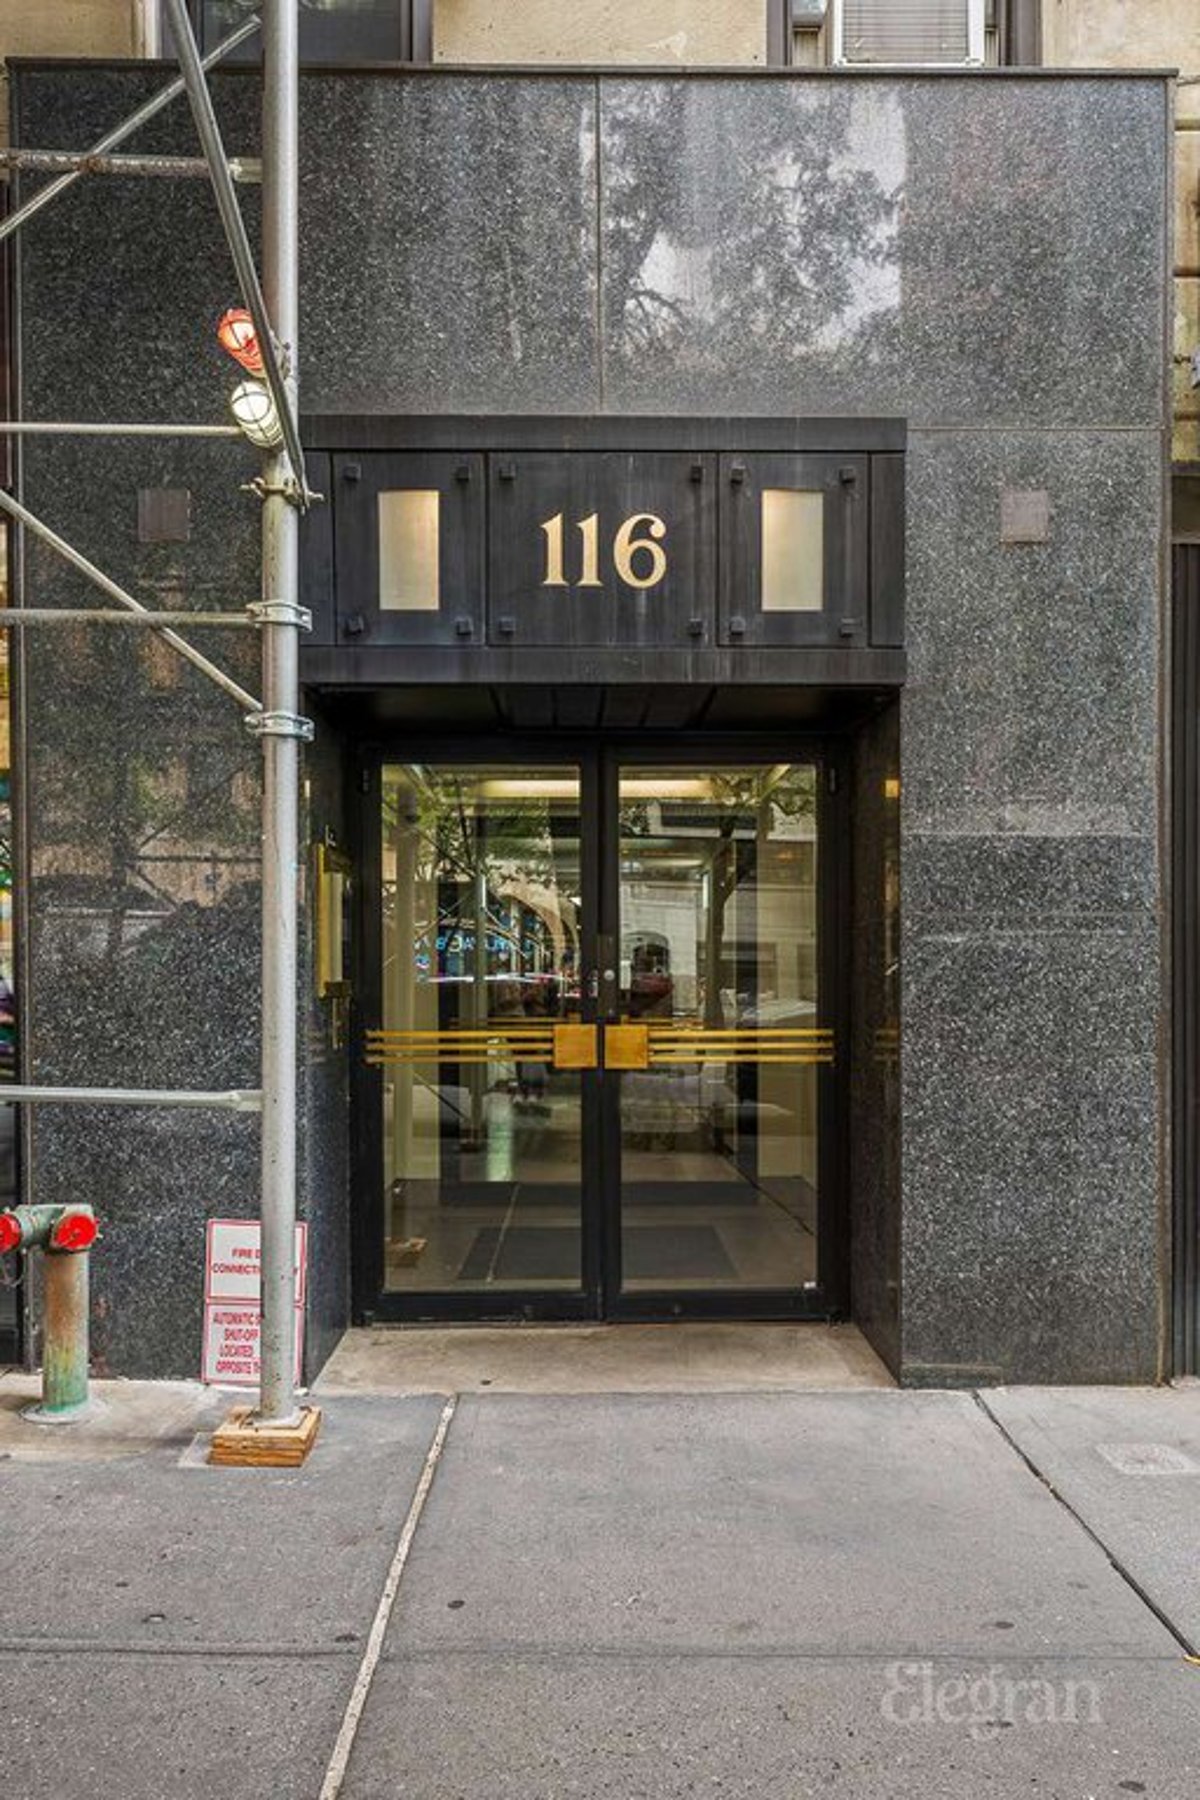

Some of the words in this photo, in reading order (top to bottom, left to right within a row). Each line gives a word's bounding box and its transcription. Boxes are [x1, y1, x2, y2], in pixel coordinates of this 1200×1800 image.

[540, 512, 667, 589] 116
[232, 1248, 252, 1258] FIRE
[213, 1312, 254, 1325] AUTOMATIC
[219, 1344, 253, 1358] LOCATED
[215, 1360, 252, 1375] OPPOSITE
